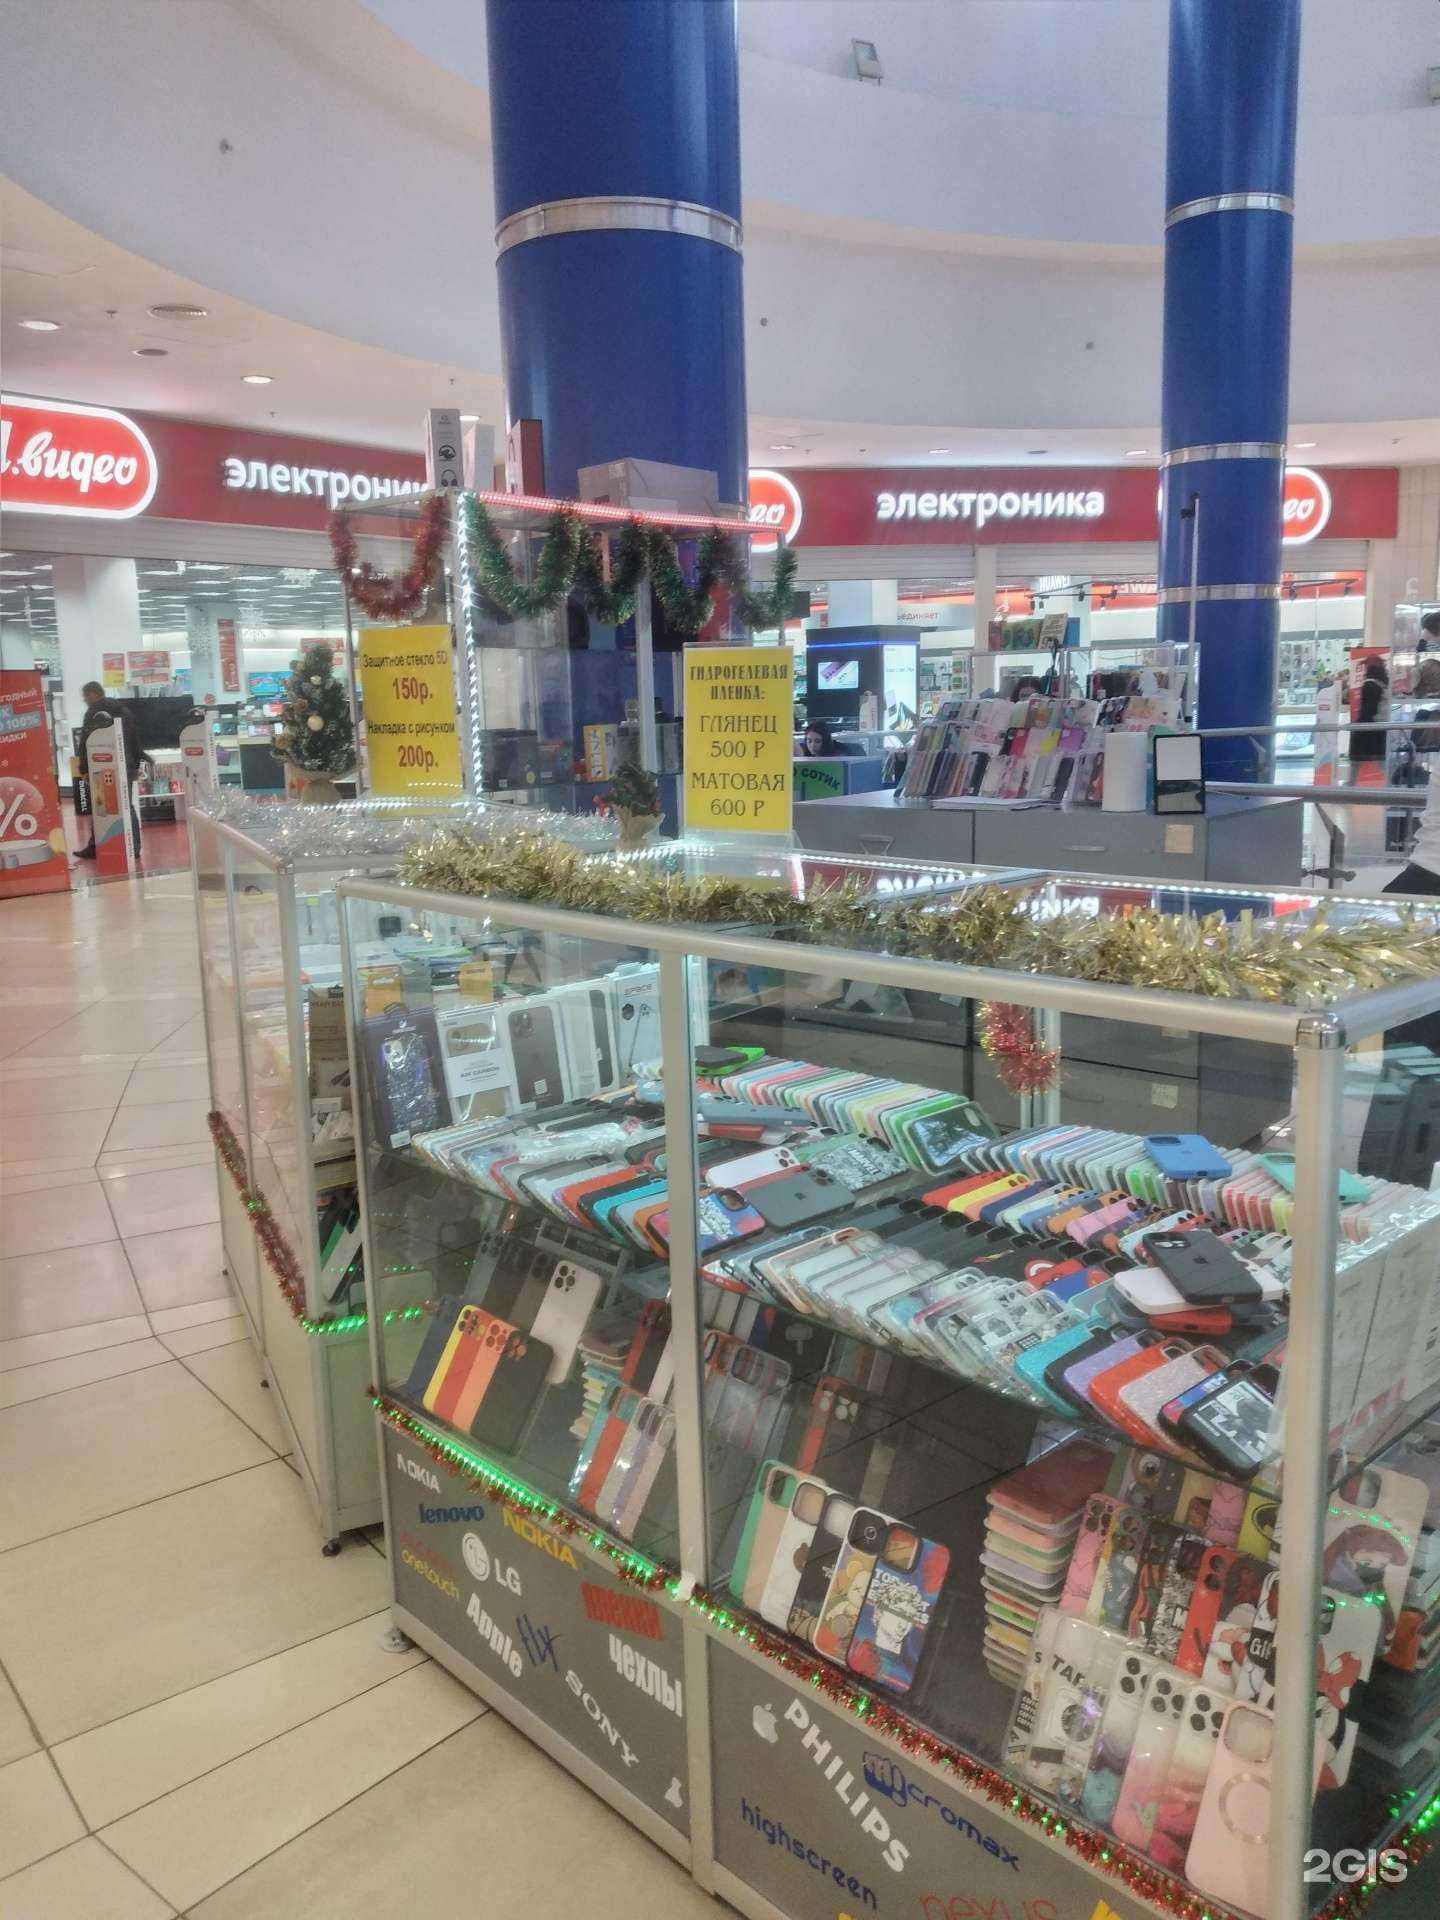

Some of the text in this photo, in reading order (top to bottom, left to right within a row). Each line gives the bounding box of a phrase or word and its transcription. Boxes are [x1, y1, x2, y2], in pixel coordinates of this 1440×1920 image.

[877, 490, 1105, 528] электроника
[363, 653, 404, 670] Защитное
[406, 655, 434, 667] стекло
[690, 664, 788, 681] ГИДРОГЕЛЕВАЯ
[392, 676, 433, 704] 150р.
[710, 685, 765, 700] ПЛЕНКА:
[368, 719, 407, 736] Накладка
[415, 722, 455, 738] рисунком
[699, 715, 777, 734] ГЛЯНЕЦ
[398, 744, 439, 772] 200р.
[711, 740, 746, 758] 500
[692, 772, 785, 791] МАТОВАЯ
[711, 799, 746, 816] 600
[418, 1503, 485, 1524] lenovo
[502, 1505, 579, 1570] NOKIA
[402, 1549, 461, 1601] onetouch
[493, 1557, 522, 1596] LG
[608, 1633, 683, 1718] чехлы
[565, 1669, 640, 1769] SONY
[784, 1698, 911, 1873] PHILIPS
[740, 1797, 879, 1911] highscreen
